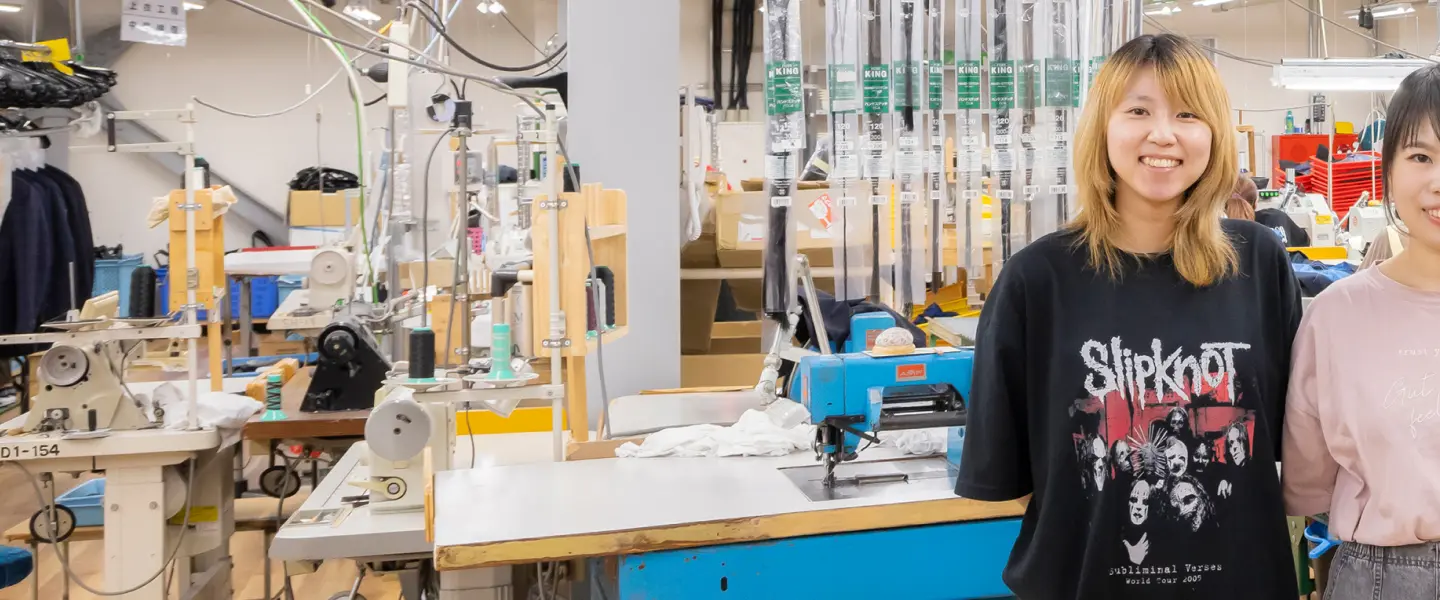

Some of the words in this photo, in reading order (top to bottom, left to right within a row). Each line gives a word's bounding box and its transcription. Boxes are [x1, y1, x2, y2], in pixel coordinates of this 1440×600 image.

[775, 67, 799, 75] KING
[864, 70, 888, 78] KING
[958, 66, 979, 74] KING
[991, 66, 1013, 74] KING
[838, 122, 851, 130] 120
[1, 444, 60, 458] D1-154
[1185, 563, 1222, 573] Verses
[1126, 577, 1151, 585] World
